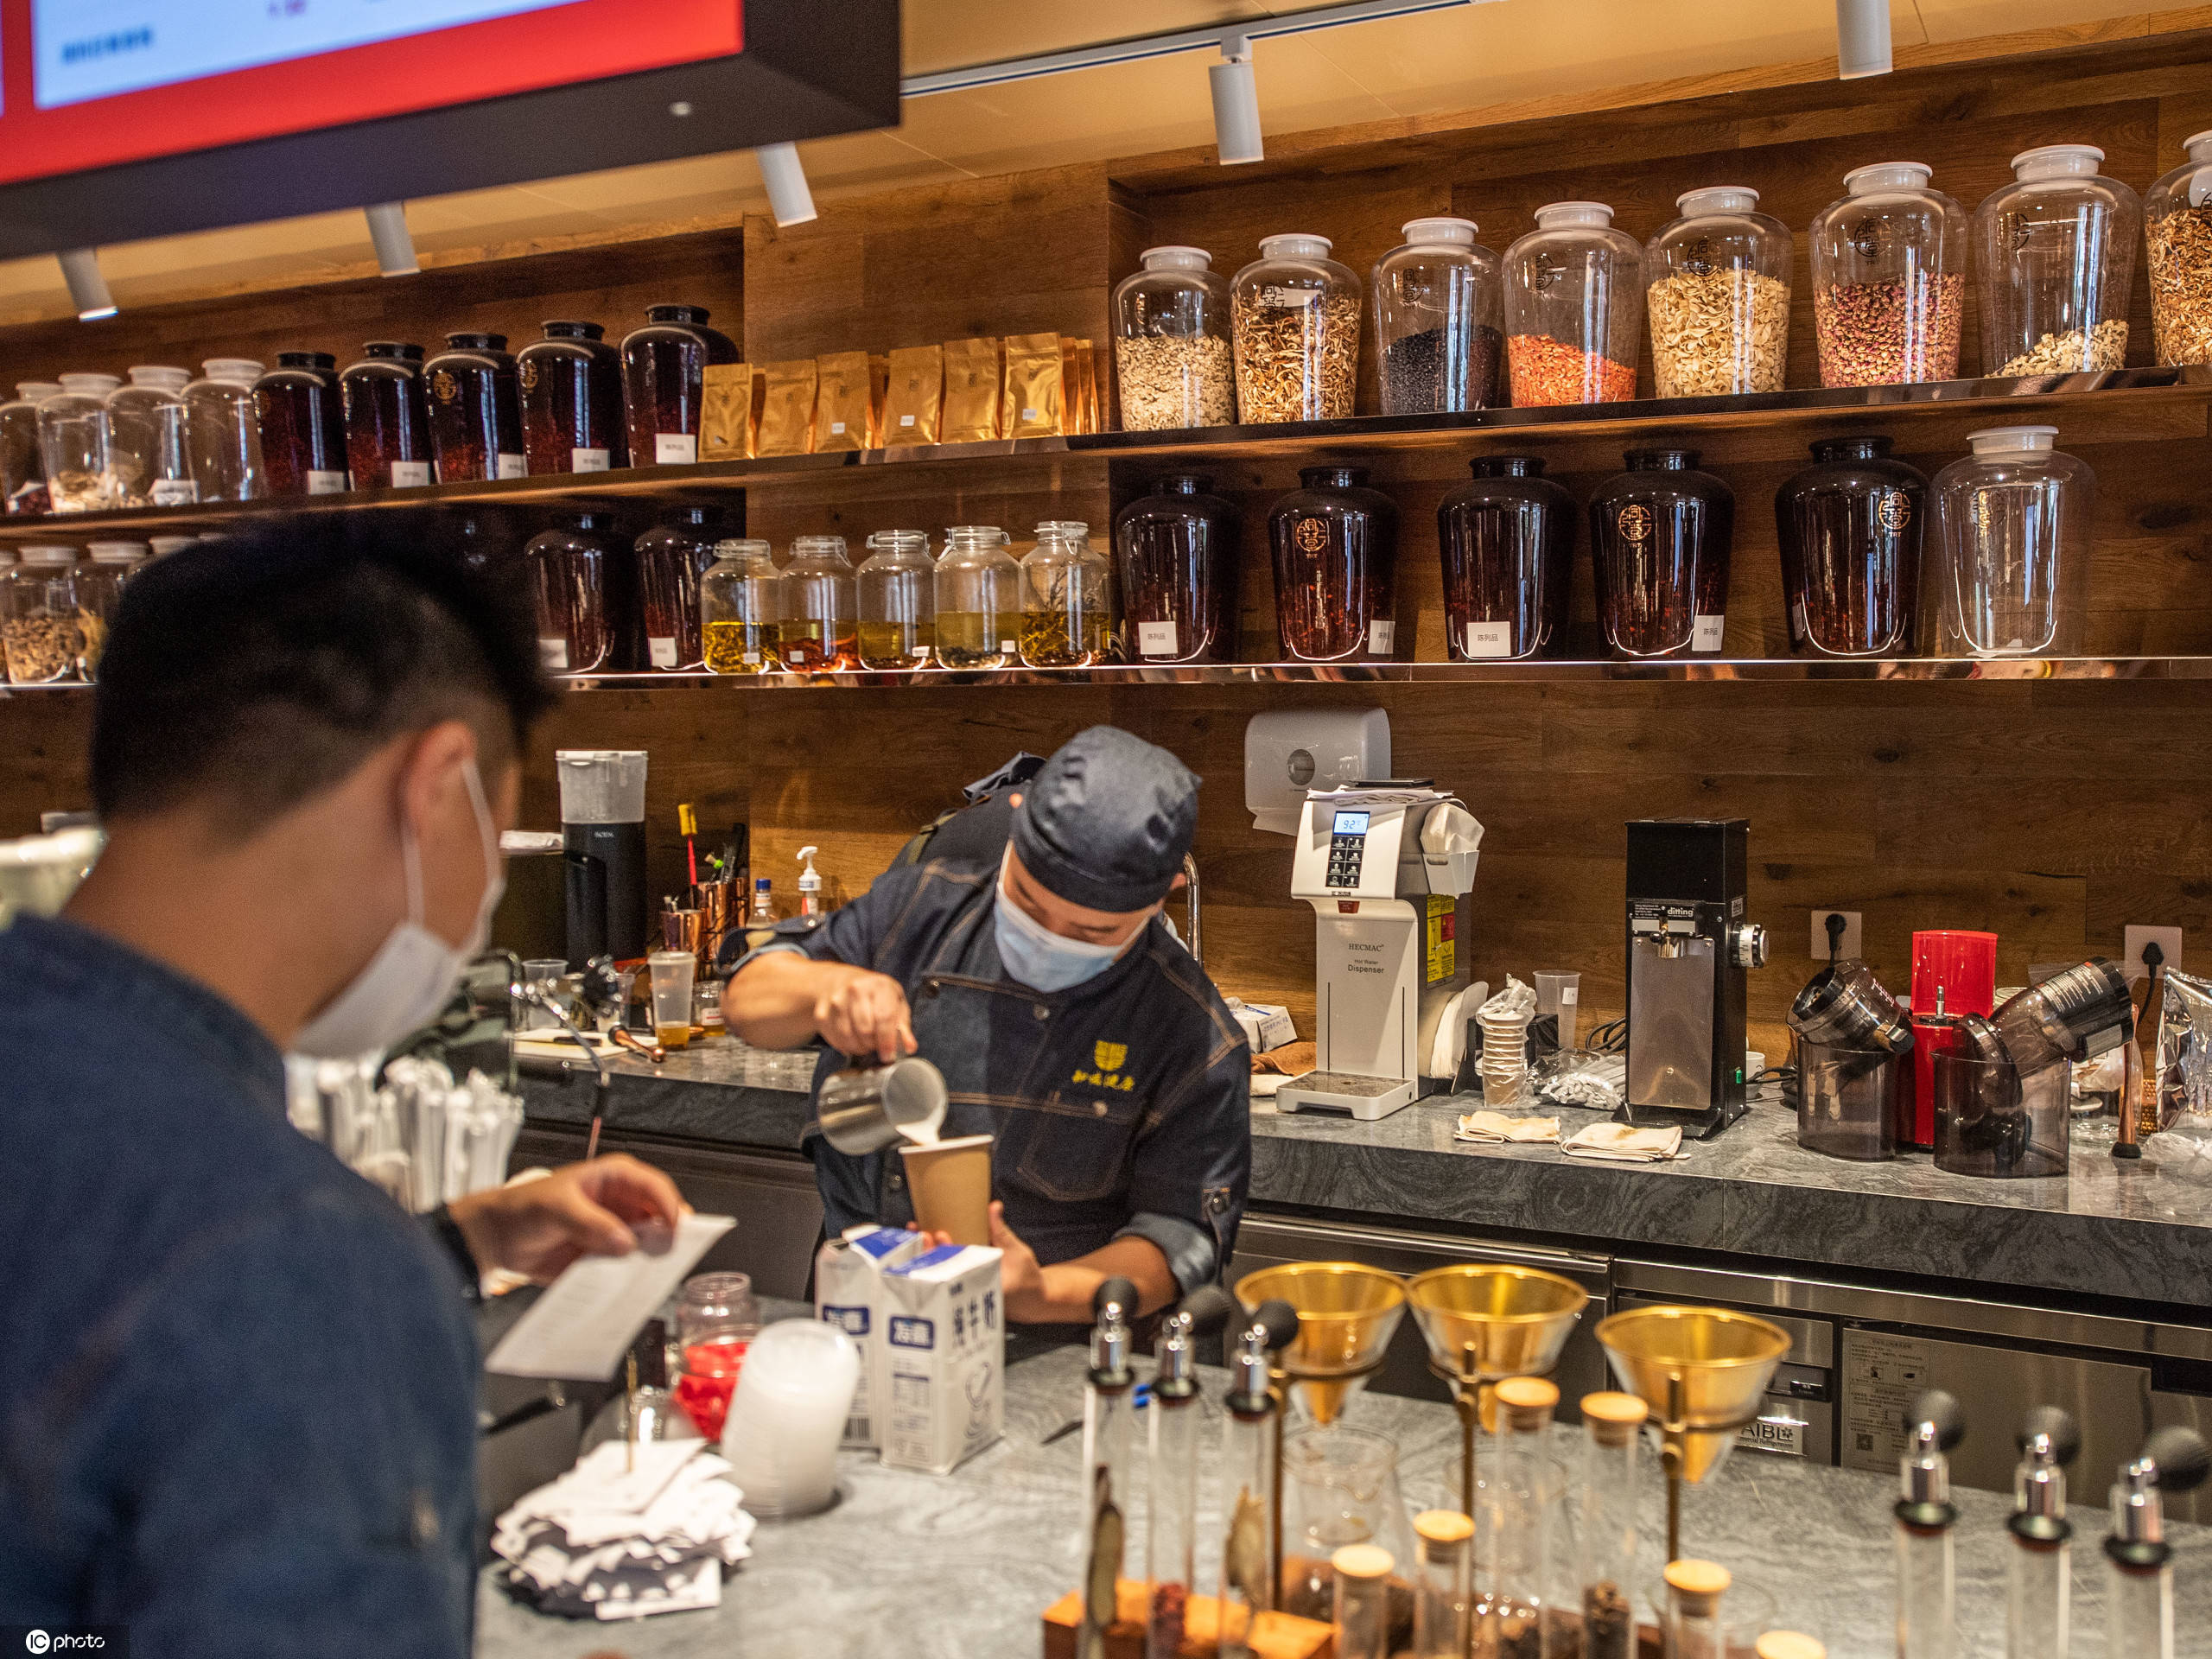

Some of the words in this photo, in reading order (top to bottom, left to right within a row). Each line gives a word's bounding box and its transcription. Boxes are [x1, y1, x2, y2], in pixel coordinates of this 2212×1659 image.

[1343, 820, 1356, 830] 92
[1667, 906, 1694, 918] ditting
[1347, 964, 1385, 974] Dispenser
